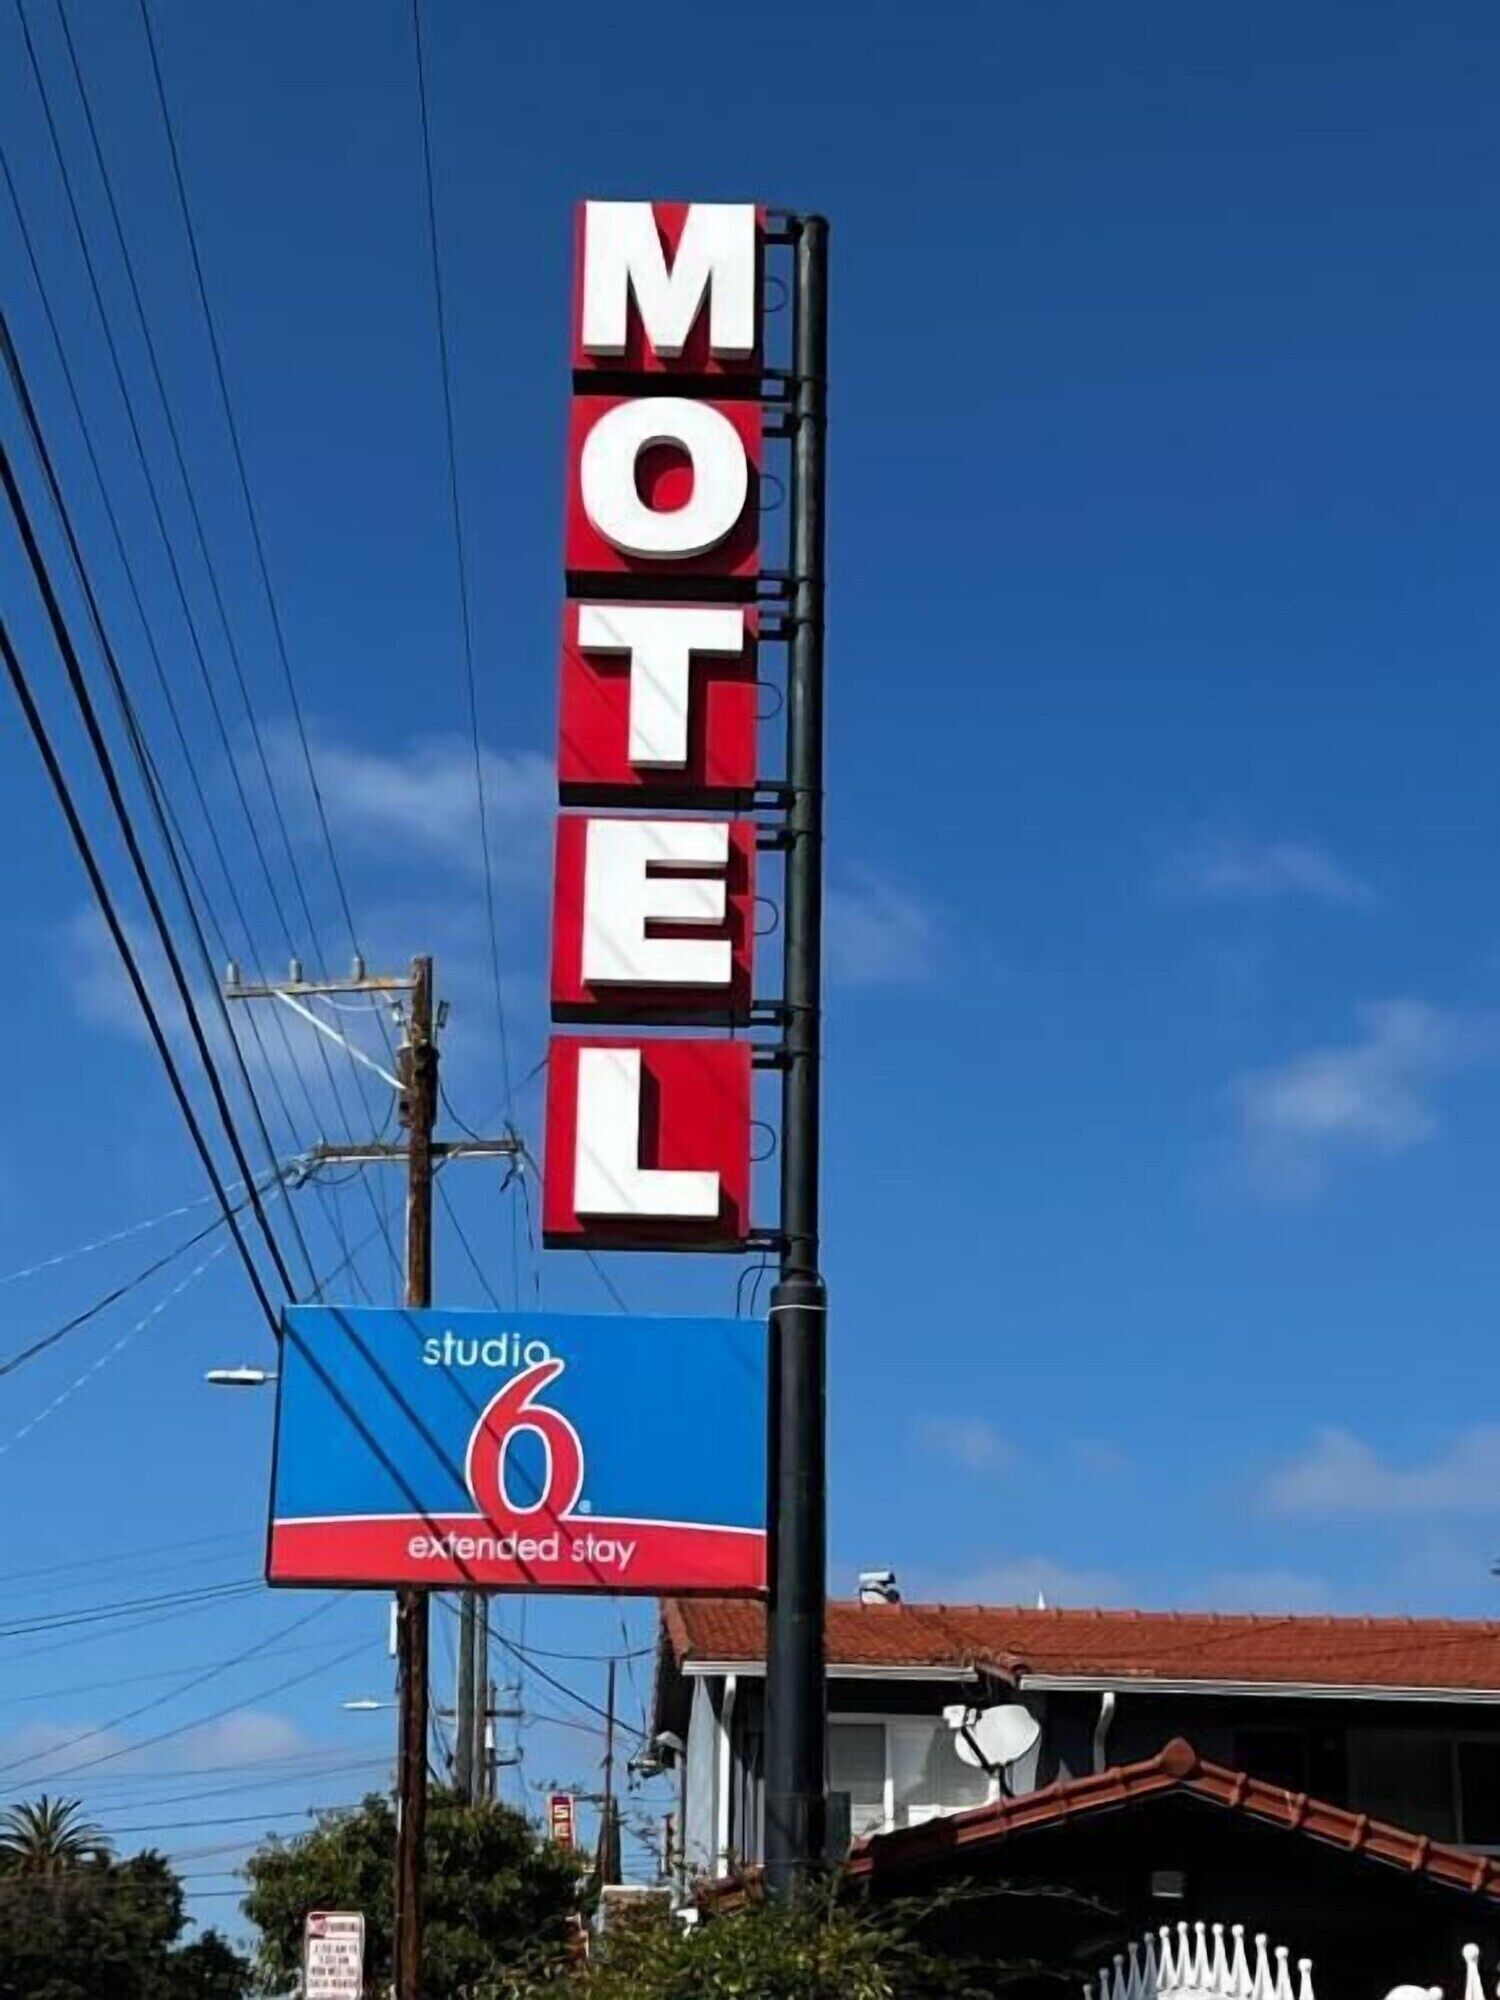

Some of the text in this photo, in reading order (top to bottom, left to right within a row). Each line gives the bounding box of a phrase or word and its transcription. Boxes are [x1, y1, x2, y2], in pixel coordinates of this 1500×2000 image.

[574, 200, 756, 1219] MOTEL
[422, 1330, 551, 1367] studio
[408, 1530, 637, 1572] extended stay
